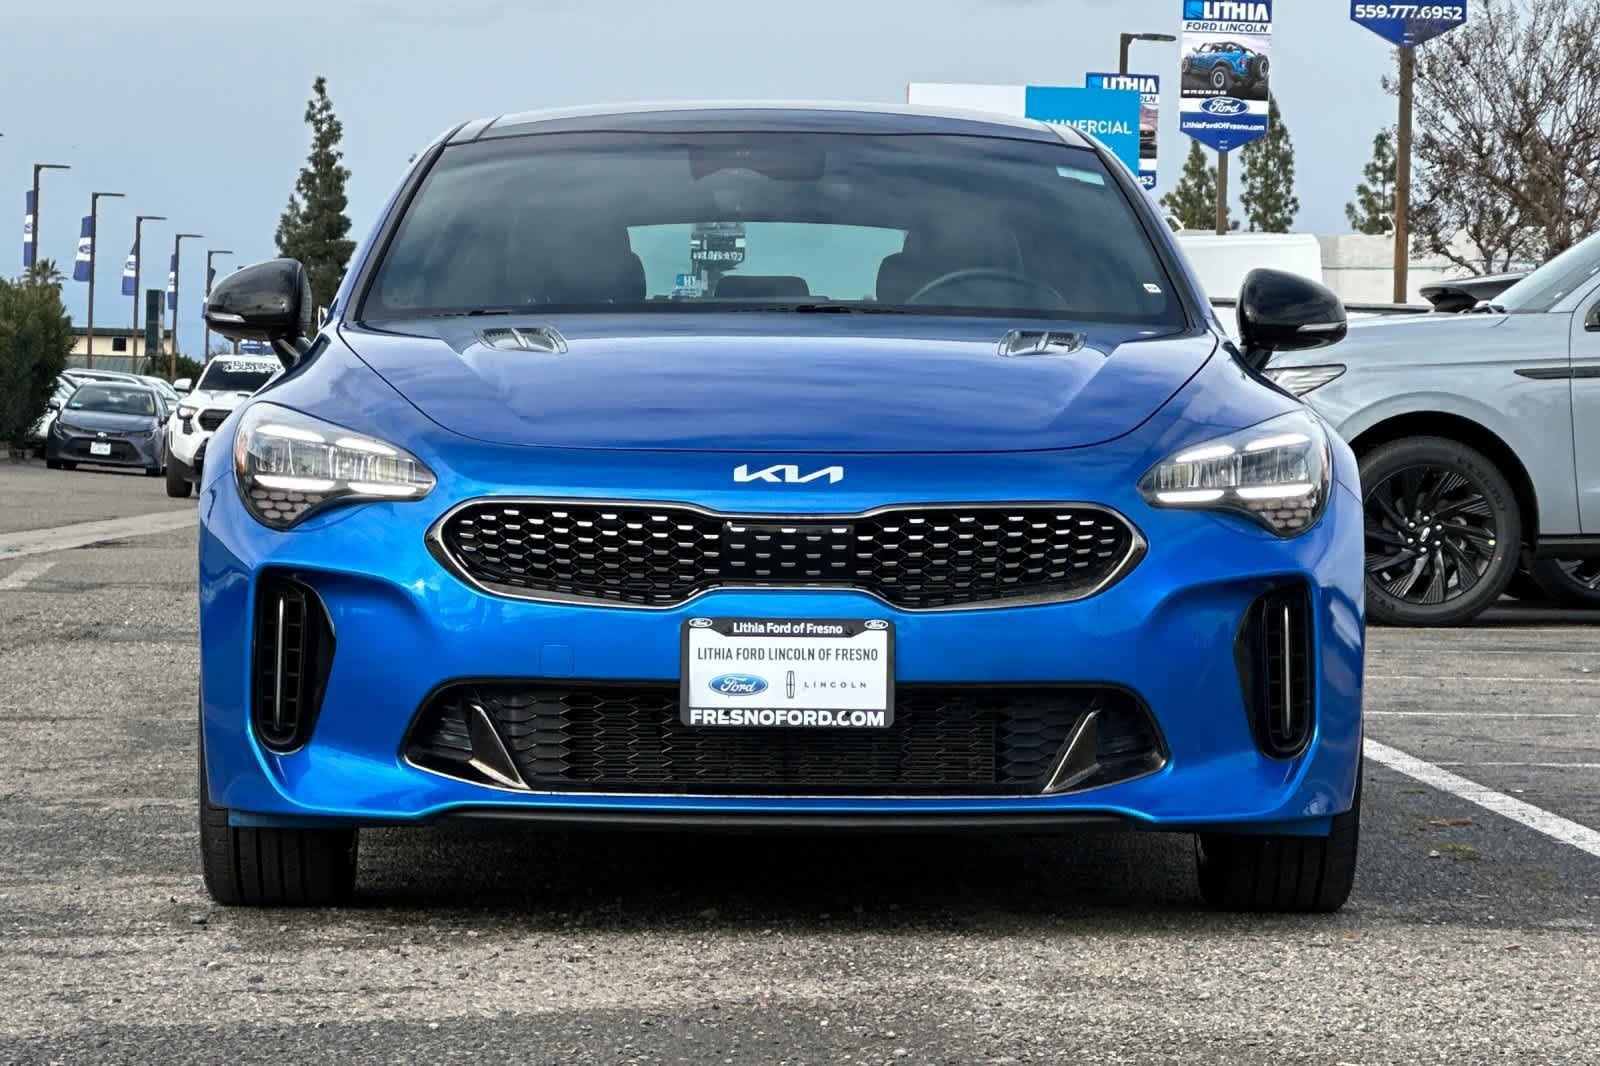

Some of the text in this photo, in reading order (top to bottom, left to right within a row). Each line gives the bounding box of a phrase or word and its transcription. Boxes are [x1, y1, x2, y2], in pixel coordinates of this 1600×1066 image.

[1203, 1, 1270, 20] LITHIA
[1355, 4, 1463, 20] 559.777.6952
[1185, 22, 1268, 33] FORD LINCOLN
[1102, 76, 1157, 93] LITHIA
[1208, 98, 1241, 113] Ford
[733, 463, 844, 485] KIA
[733, 622, 843, 634] Lithia Ford of Fresno
[697, 647, 879, 661] LITHIA FORD LINCOLN OF FRESNO
[718, 675, 758, 693] Ford
[803, 681, 867, 689] LINCOLN
[689, 708, 886, 727] FRESNOFORD.COM
